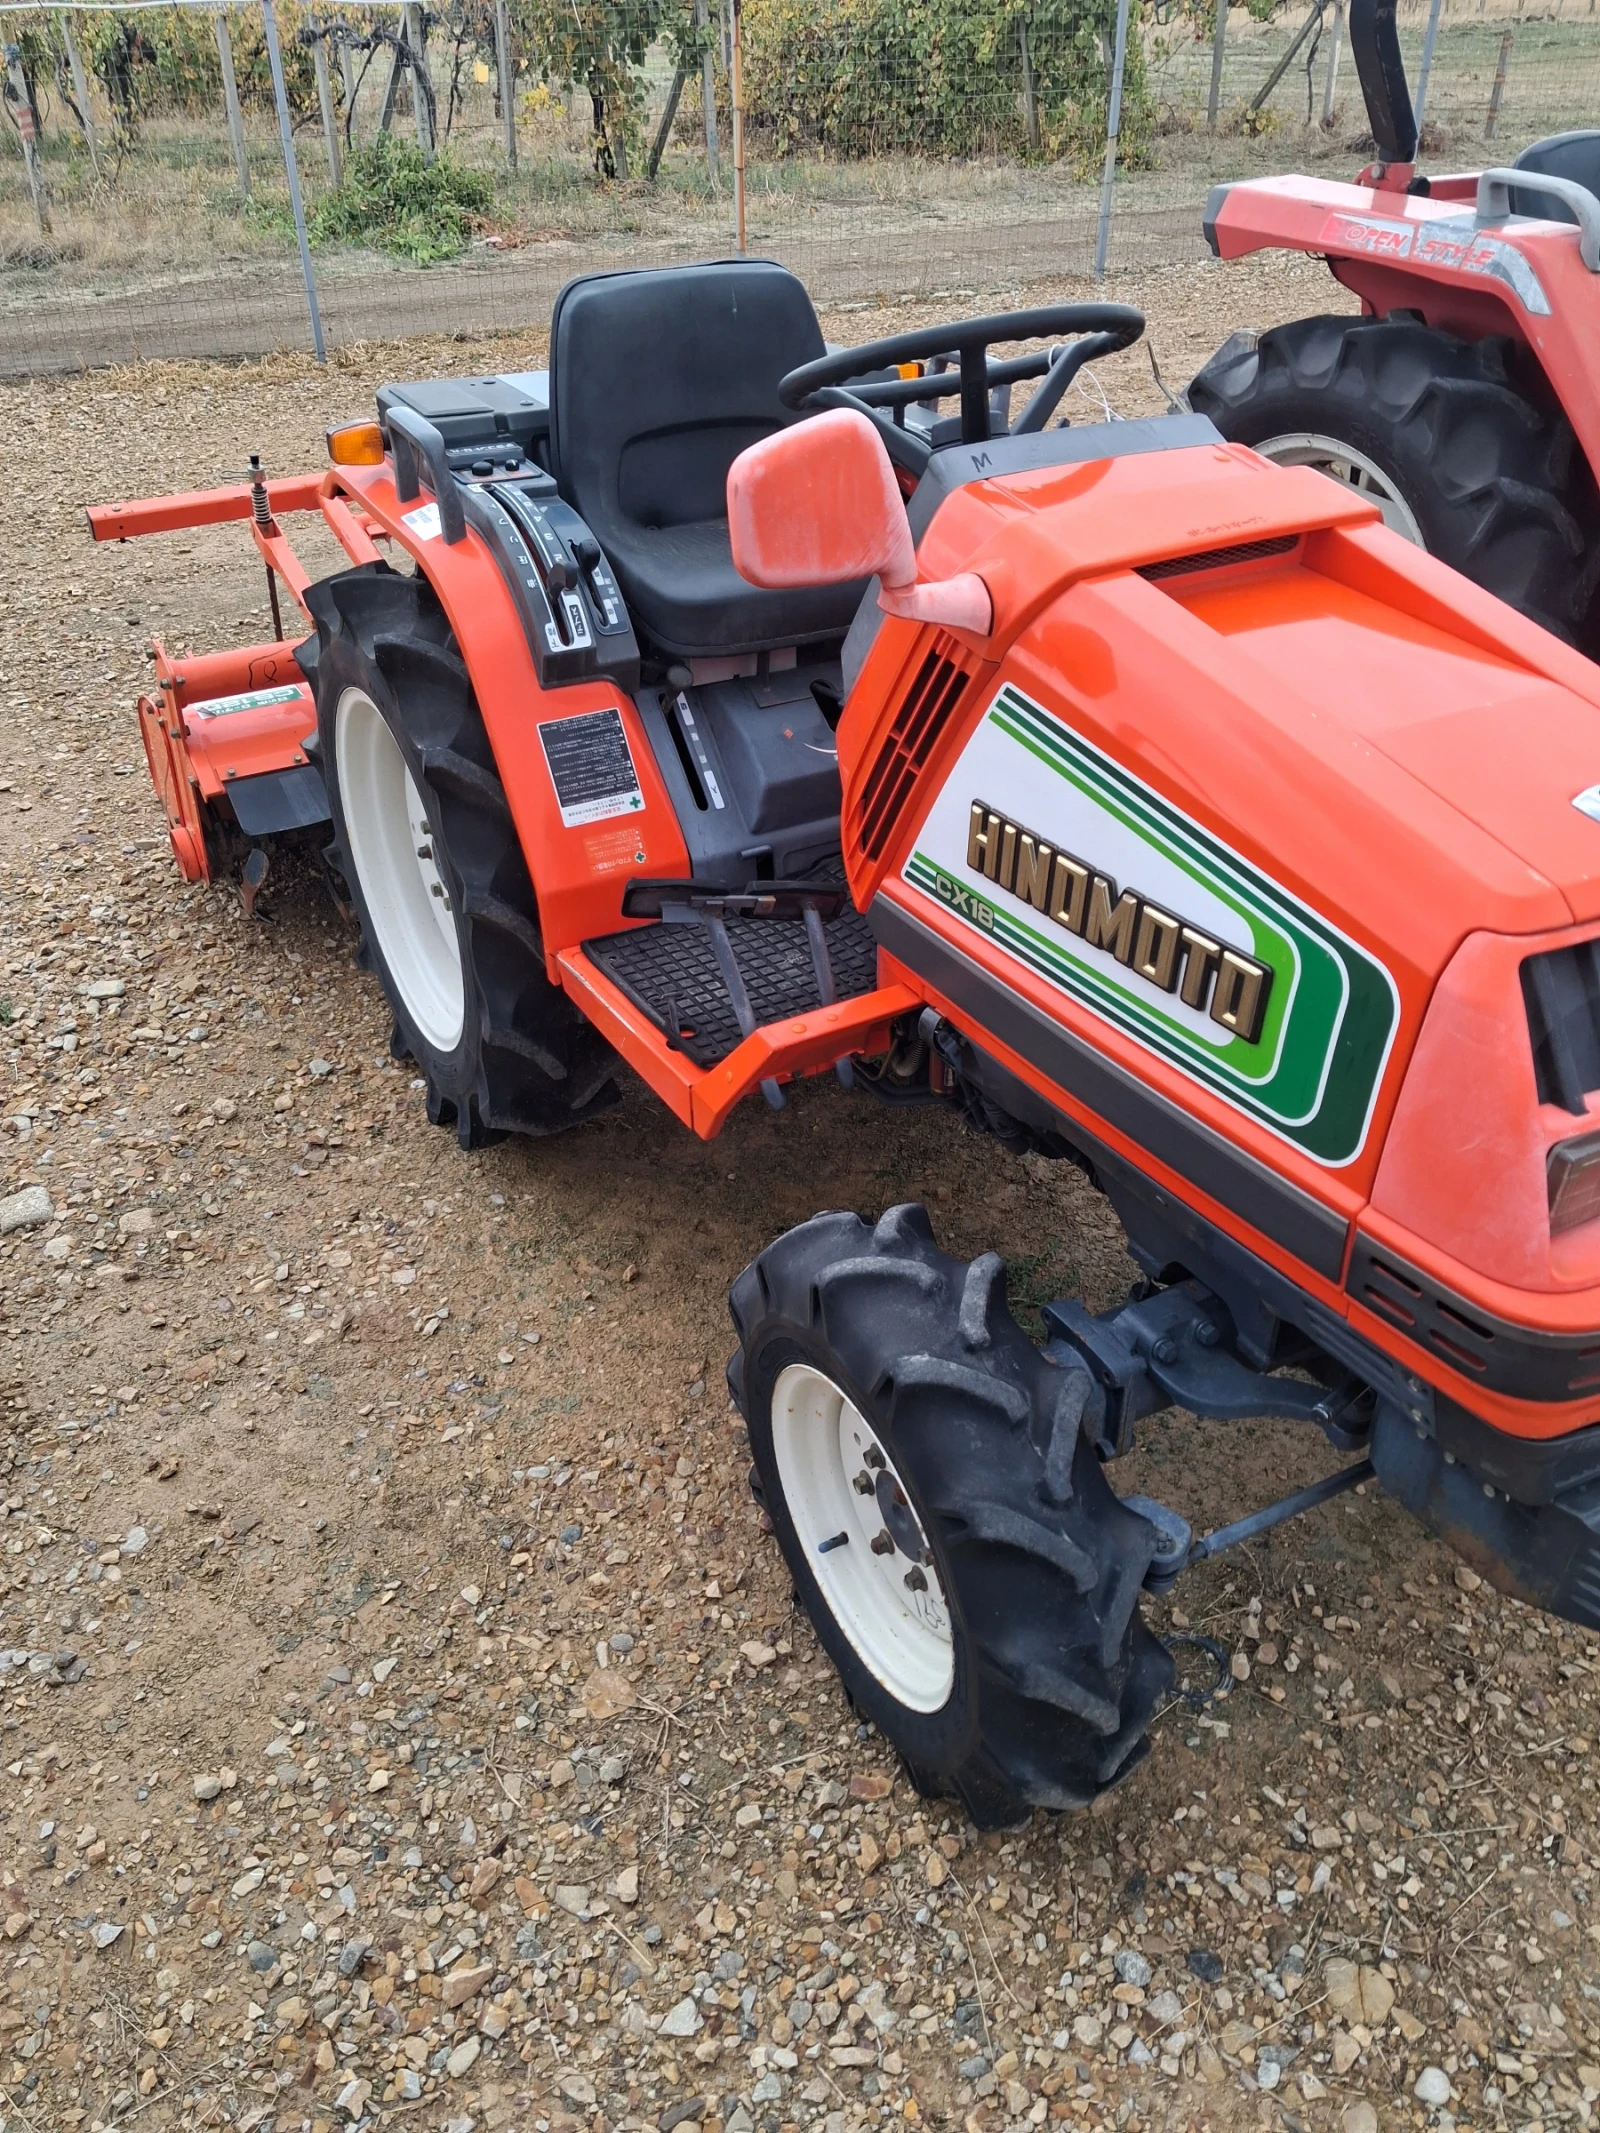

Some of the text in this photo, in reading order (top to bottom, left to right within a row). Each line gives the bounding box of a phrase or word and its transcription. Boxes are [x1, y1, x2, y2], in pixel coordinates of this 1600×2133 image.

[1346, 225, 1495, 265] OPEN STYLE
[971, 452, 993, 474] M
[935, 872, 995, 930] CX18
[967, 798, 1274, 1045] HINOMOTO
